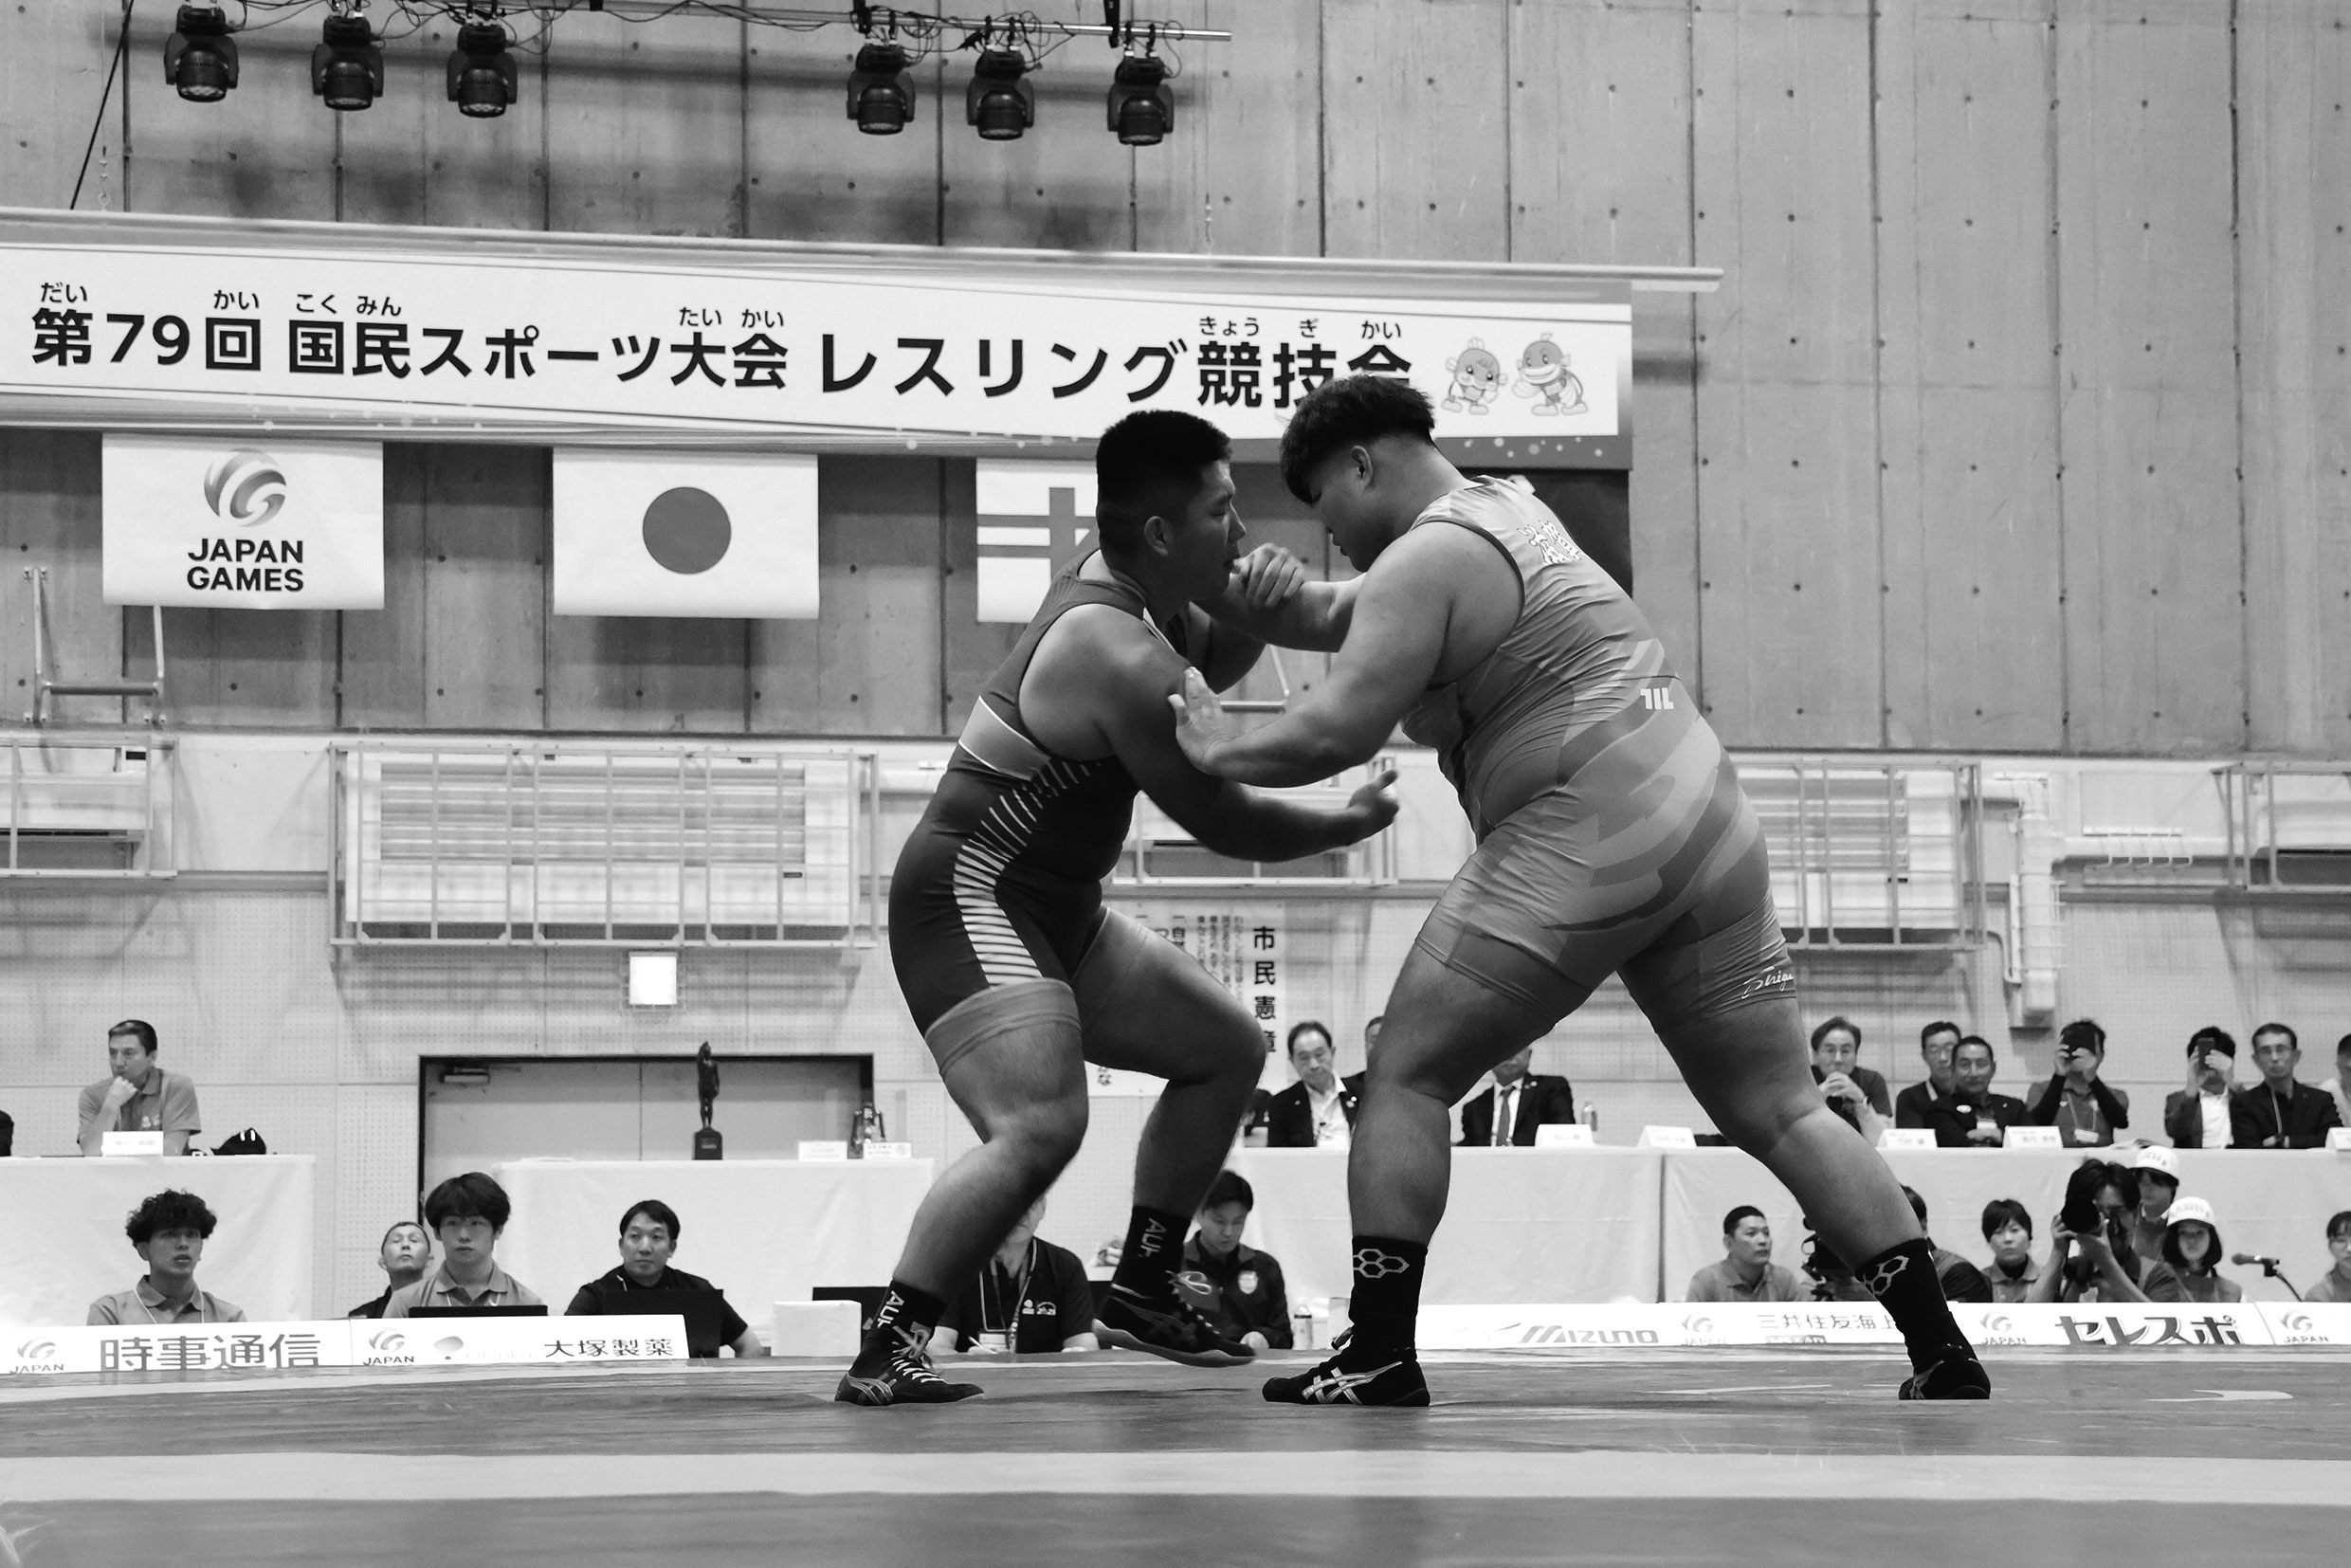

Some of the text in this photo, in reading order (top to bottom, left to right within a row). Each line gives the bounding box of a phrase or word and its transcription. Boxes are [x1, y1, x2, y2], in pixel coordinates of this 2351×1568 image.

[41, 282, 1401, 339] だい かい こく みん たい かい きょう ぎ かい
[31, 307, 262, 372] 第79回
[288, 319, 789, 390] 国民スポーツ大会
[188, 538, 303, 563] JAPAN
[187, 566, 304, 593] GAMES
[2055, 1315, 2243, 1345] セレスポ
[100, 1333, 320, 1371] 時事通信
[363, 1356, 414, 1365] JAPAN
[544, 1339, 673, 1358] 大塚製薬
[9, 1363, 64, 1374] JAPAN
